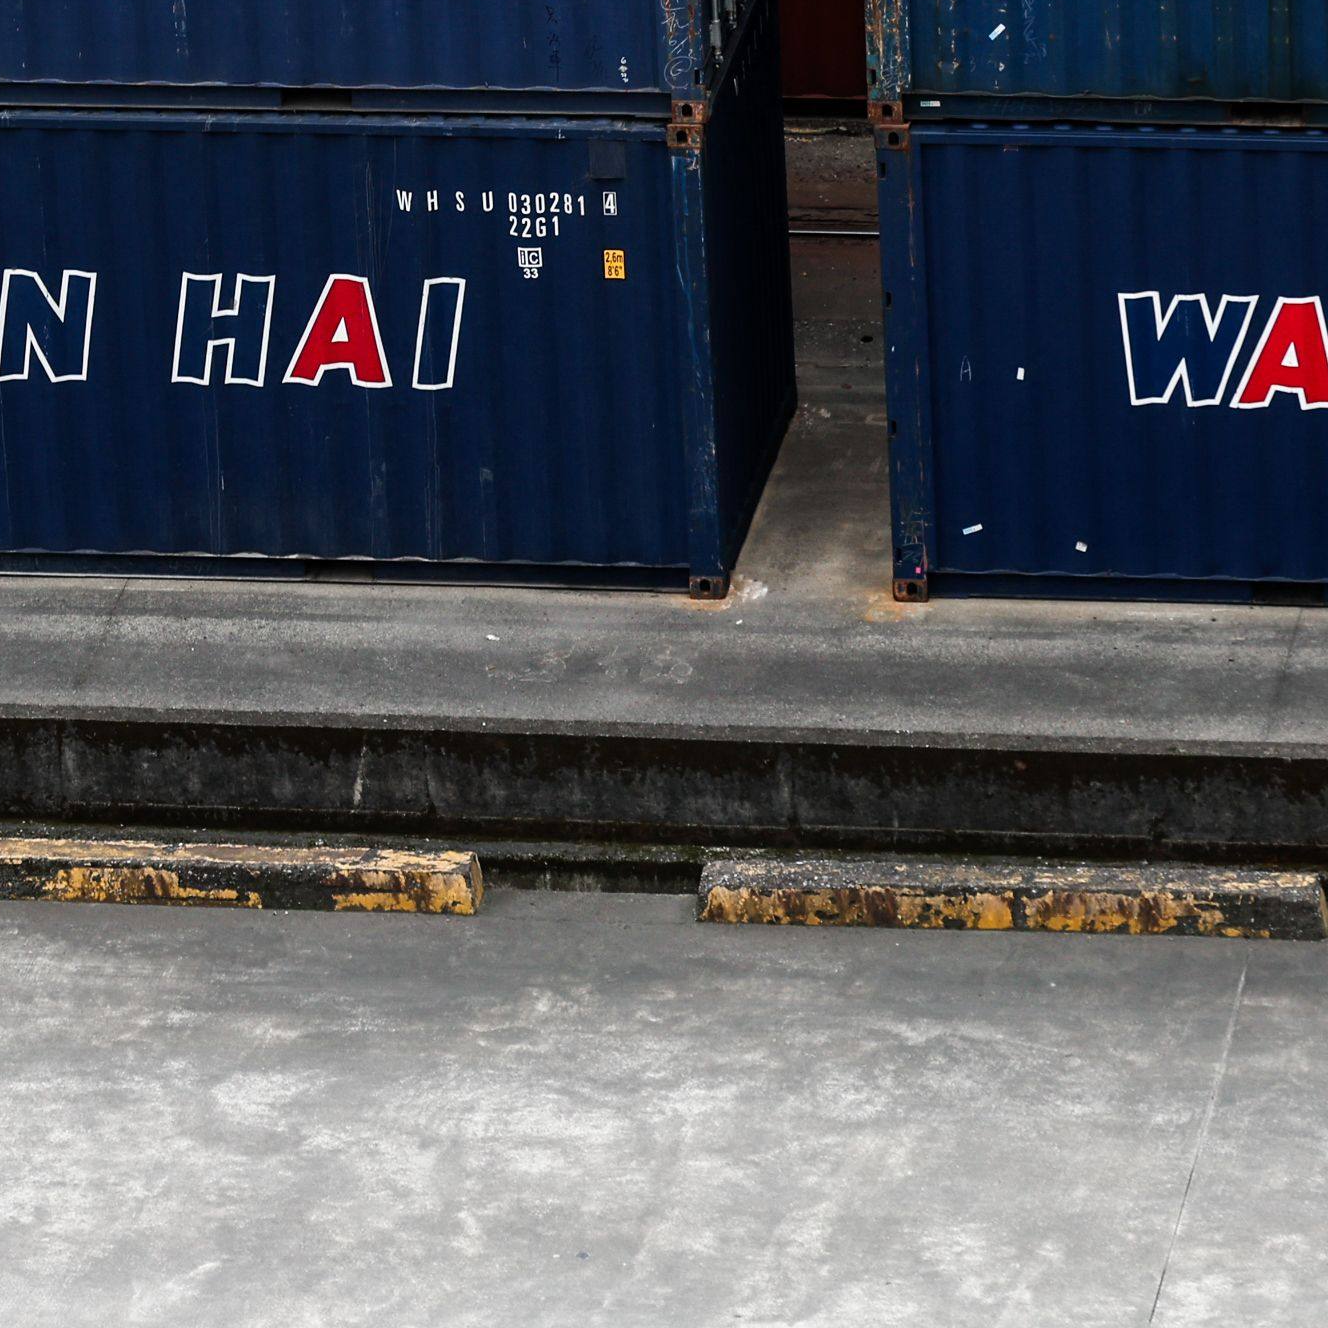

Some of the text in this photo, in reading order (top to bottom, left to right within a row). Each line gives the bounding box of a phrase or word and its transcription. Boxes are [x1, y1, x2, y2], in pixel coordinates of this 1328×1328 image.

[508, 192, 585, 216] 030281
[509, 215, 559, 238] 22G1
[523, 268, 539, 279] 33
[171, 272, 466, 390] HAI
